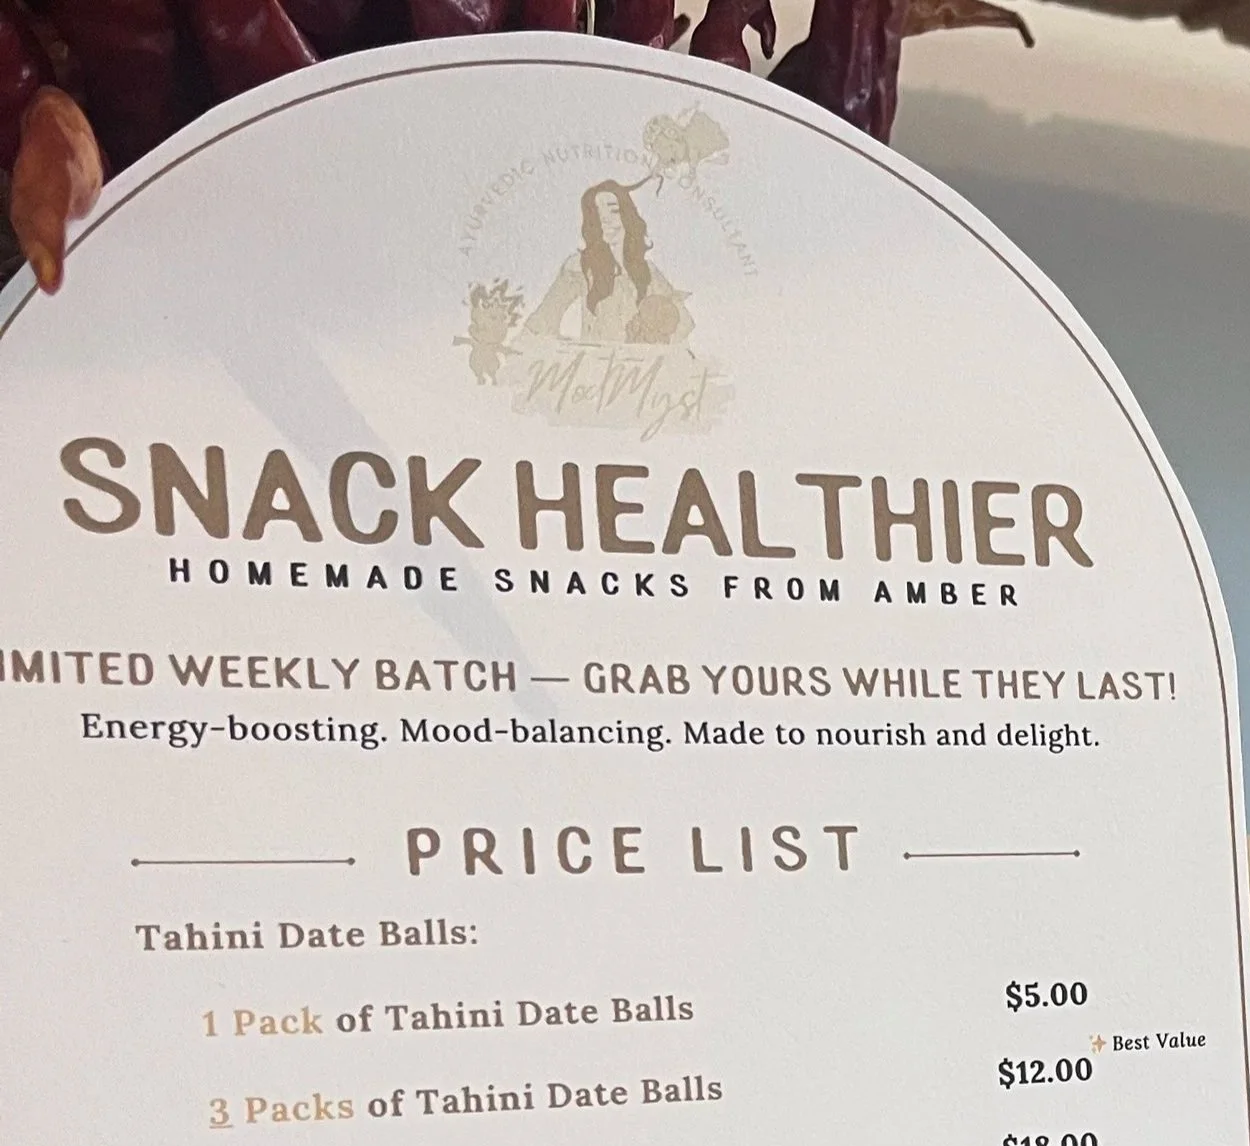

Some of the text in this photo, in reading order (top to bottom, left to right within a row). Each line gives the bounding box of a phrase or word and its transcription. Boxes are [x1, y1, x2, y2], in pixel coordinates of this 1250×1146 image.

[60, 437, 1094, 568] SNACK HEALTHIER
[169, 557, 1017, 606] HOMEMADE SNACKS FROM AMBER
[168, 654, 360, 690] WEEKLY
[375, 659, 516, 692] BATCH
[584, 662, 690, 695] GRAB
[701, 665, 831, 696] YOURS
[842, 667, 962, 698] WHILE
[971, 670, 1065, 699] THEY
[1077, 671, 1175, 700] LAST!
[80, 713, 1099, 754] Energy-boosting. Mood-balancing. Made to nourish and delight.
[407, 825, 858, 876] PRICE LIST
[135, 918, 477, 951] Tahini Date Balls:
[203, 995, 694, 1037] 1 Pack of Tahini Date Balls
[1006, 980, 1088, 1013] $5.00
[1113, 1031, 1206, 1051] Best Value
[998, 1057, 1093, 1090] $12.00
[209, 1074, 723, 1129] 3 Packs of Tahini Date Balls
